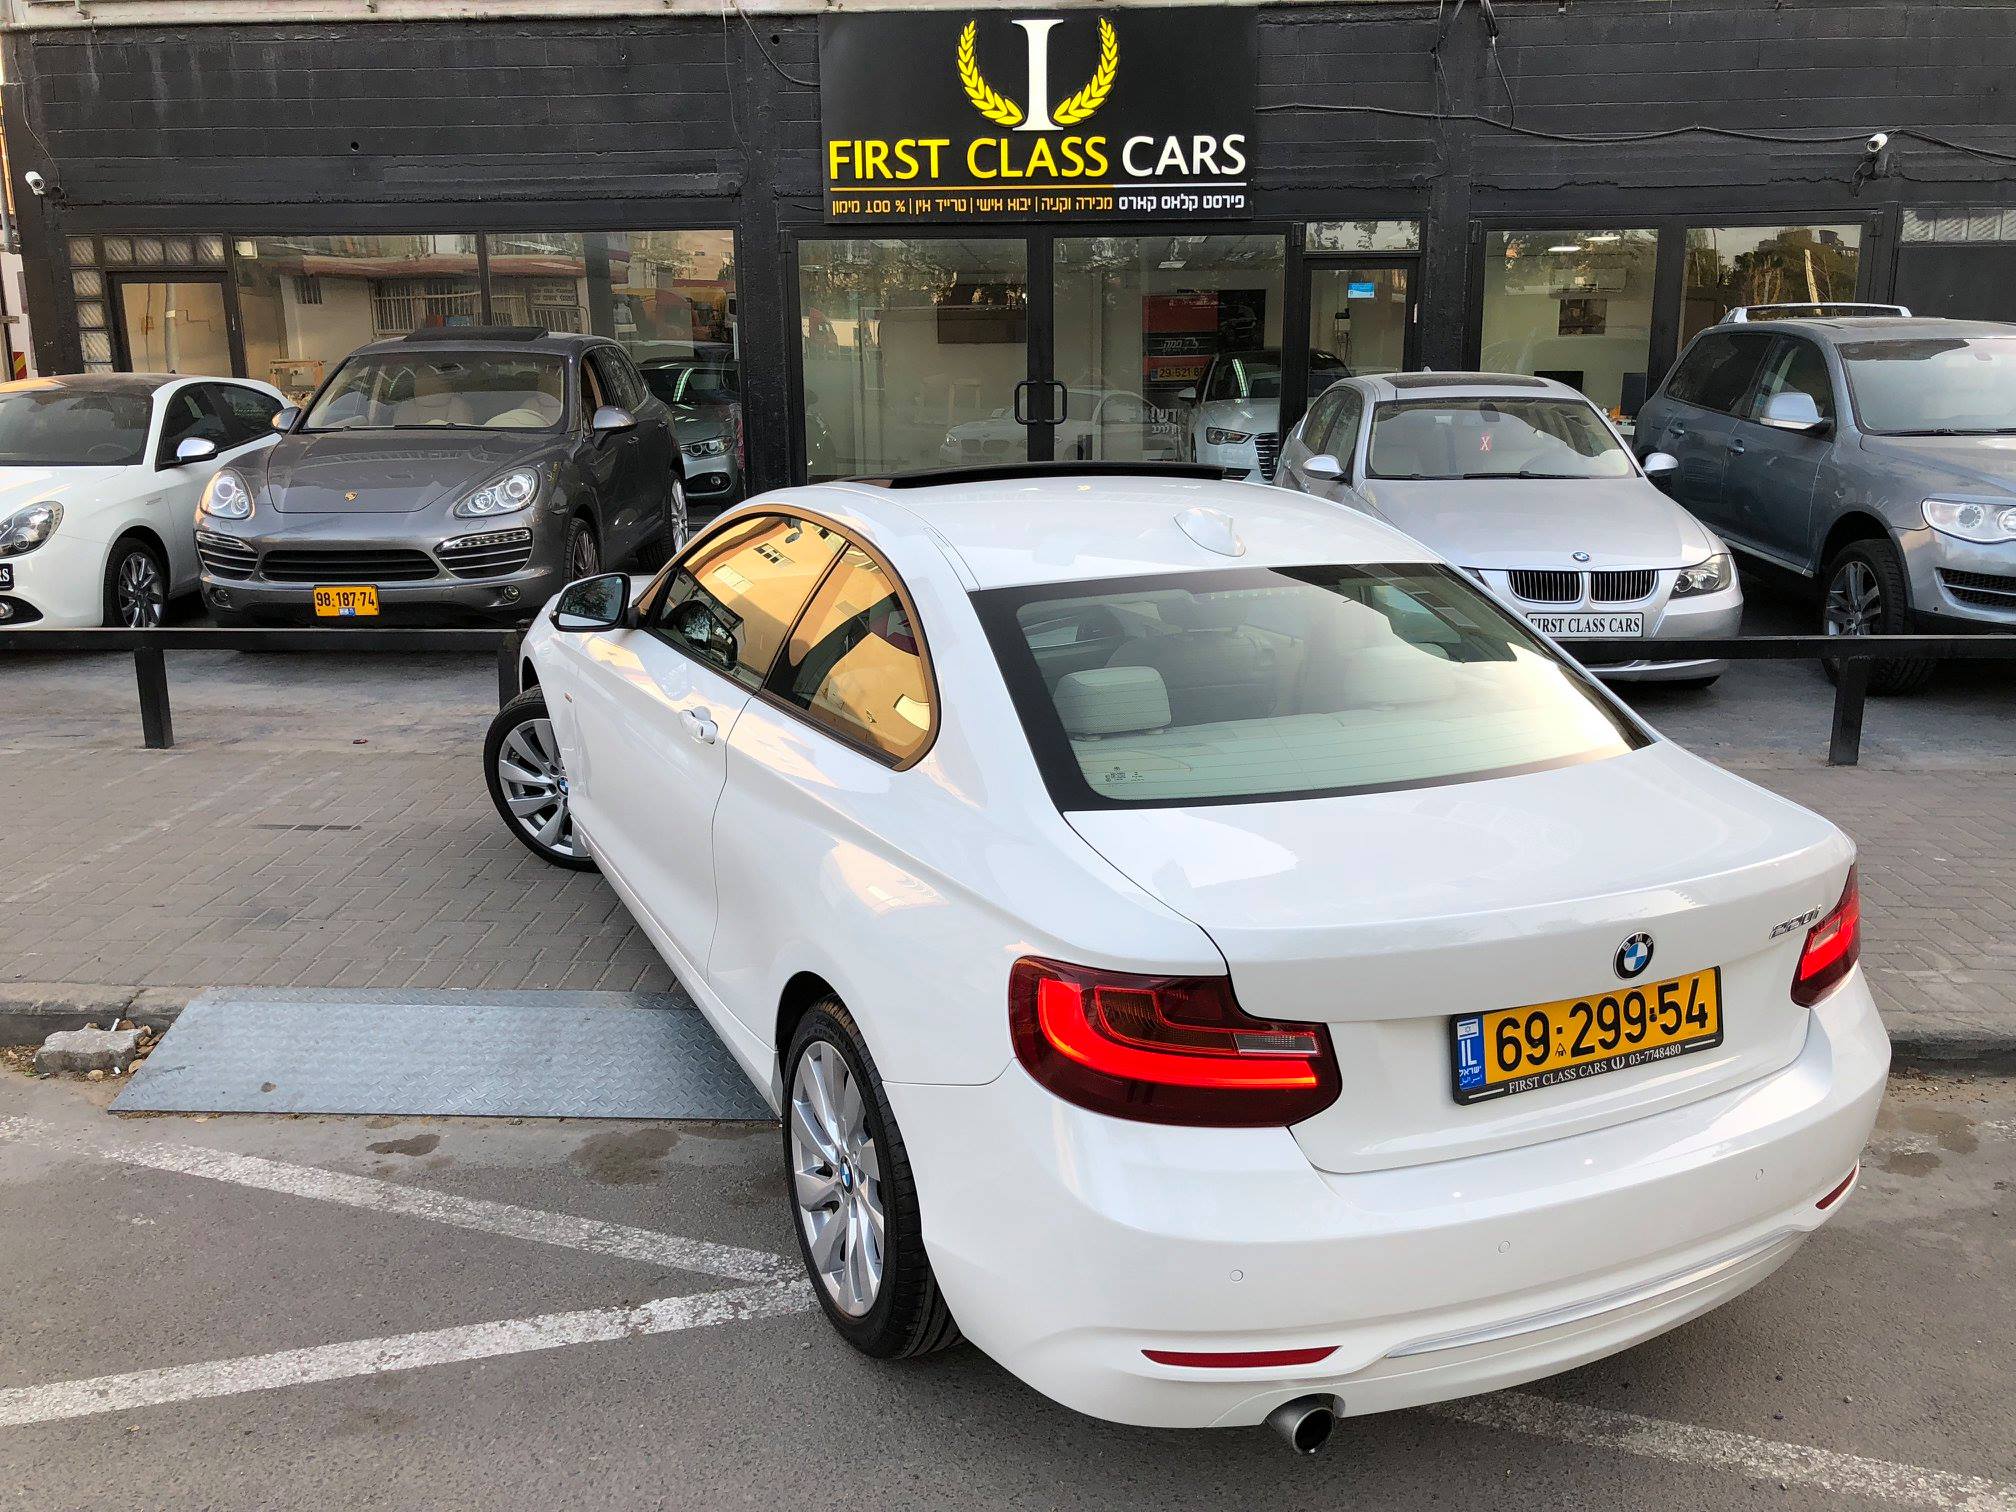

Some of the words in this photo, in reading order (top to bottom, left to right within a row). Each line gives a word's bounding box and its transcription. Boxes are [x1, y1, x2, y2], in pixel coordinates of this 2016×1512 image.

[829, 138, 950, 180] FIRST
[966, 135, 1108, 179] CLASS
[1122, 134, 1247, 177] CARS
[832, 200, 861, 216] מימון
[915, 199, 931, 215] אין
[934, 198, 967, 212] טרייד
[976, 198, 1003, 212] אישי
[1007, 197, 1032, 211] יבוא
[1041, 197, 1072, 213] וקניה
[1075, 196, 1113, 211] מכירה
[1118, 195, 1157, 213] קארס
[1161, 193, 1199, 212] קלאס
[1202, 195, 1245, 209] פירסט
[1568, 617, 1606, 633] CLASS
[1609, 617, 1640, 633] CARS
[1768, 904, 1822, 940] 220i
[1461, 1039, 1478, 1068] IL
[1508, 1075, 1540, 1095] FIRST
[1542, 1067, 1577, 1086] CLASS
[1579, 1060, 1608, 1078] CARS
[1628, 1043, 1682, 1066] 03-7748480
